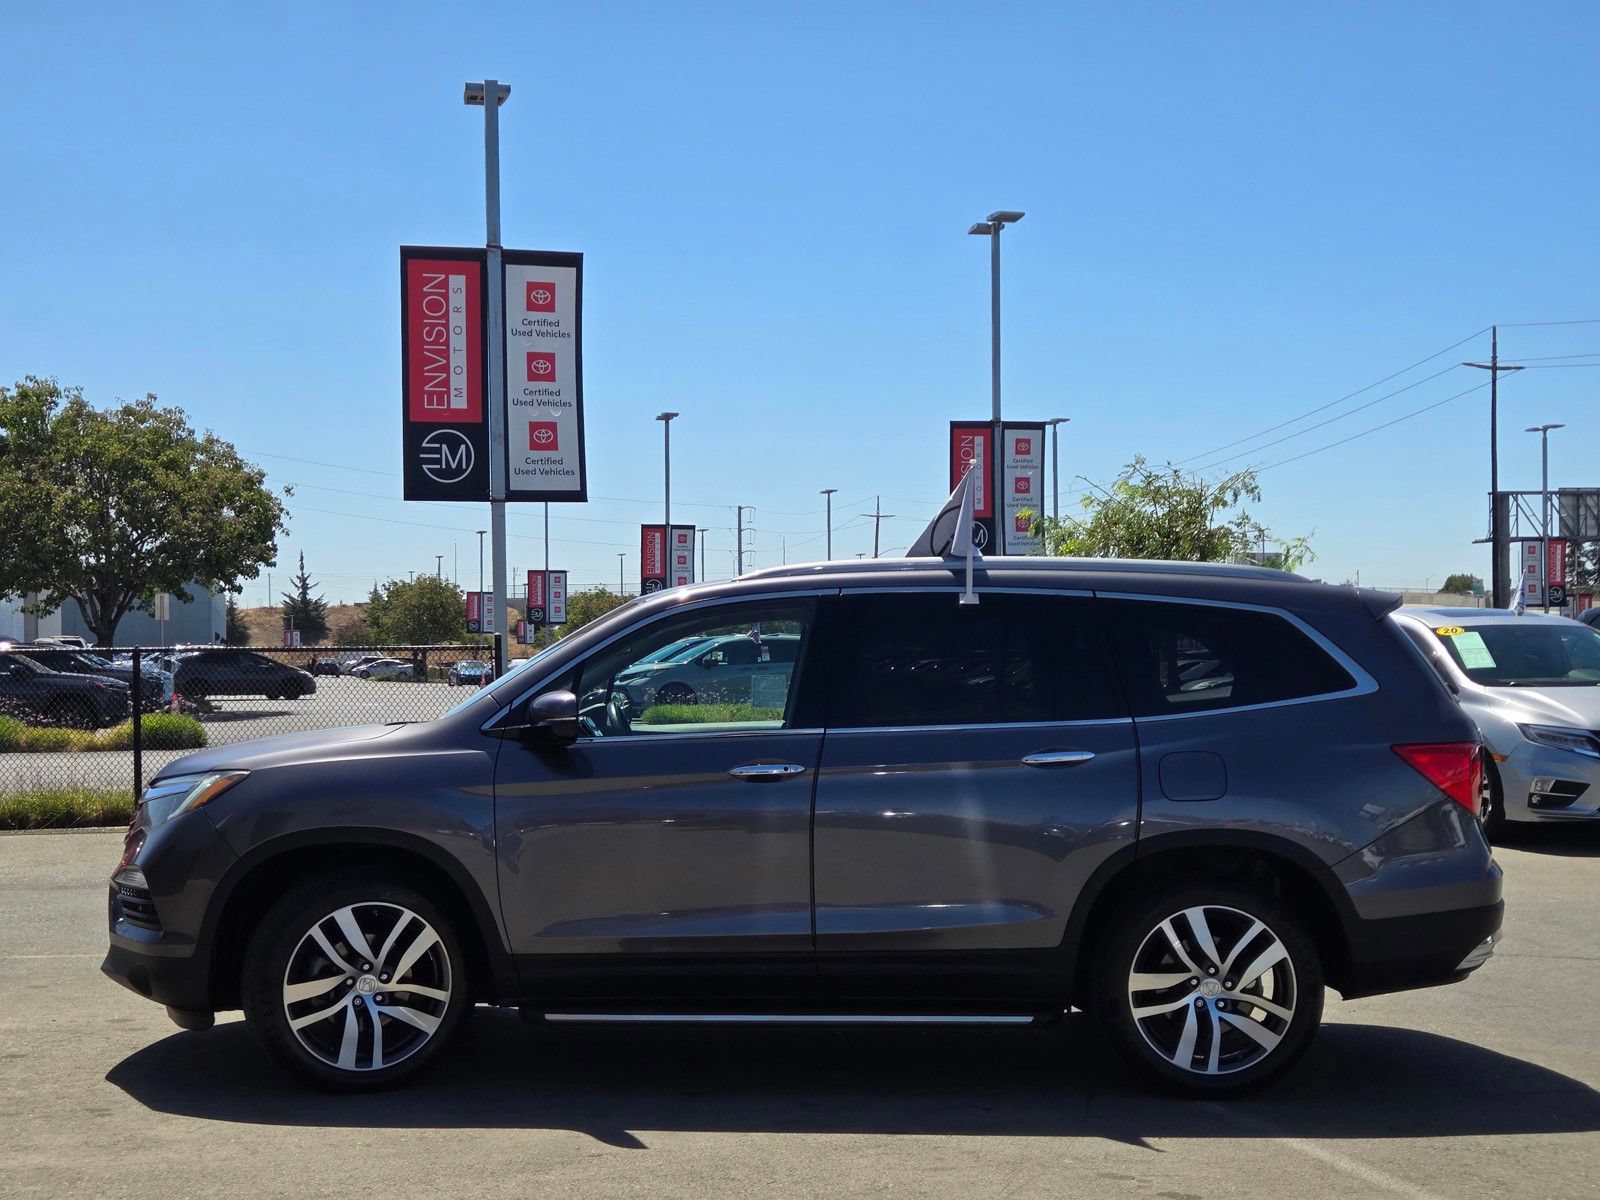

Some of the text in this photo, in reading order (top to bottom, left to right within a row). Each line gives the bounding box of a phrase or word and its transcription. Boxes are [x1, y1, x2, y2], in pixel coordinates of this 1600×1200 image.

[521, 318, 560, 327] Certified
[511, 328, 571, 338] Used Vehicles
[422, 273, 448, 409] ENVISION
[452, 287, 464, 398] MOTORS
[523, 388, 561, 397] Certified
[512, 398, 572, 408] Used Vehicles
[525, 457, 564, 465] Certified
[514, 468, 575, 476] Used Vehicles
[647, 531, 655, 574] ENVISION
